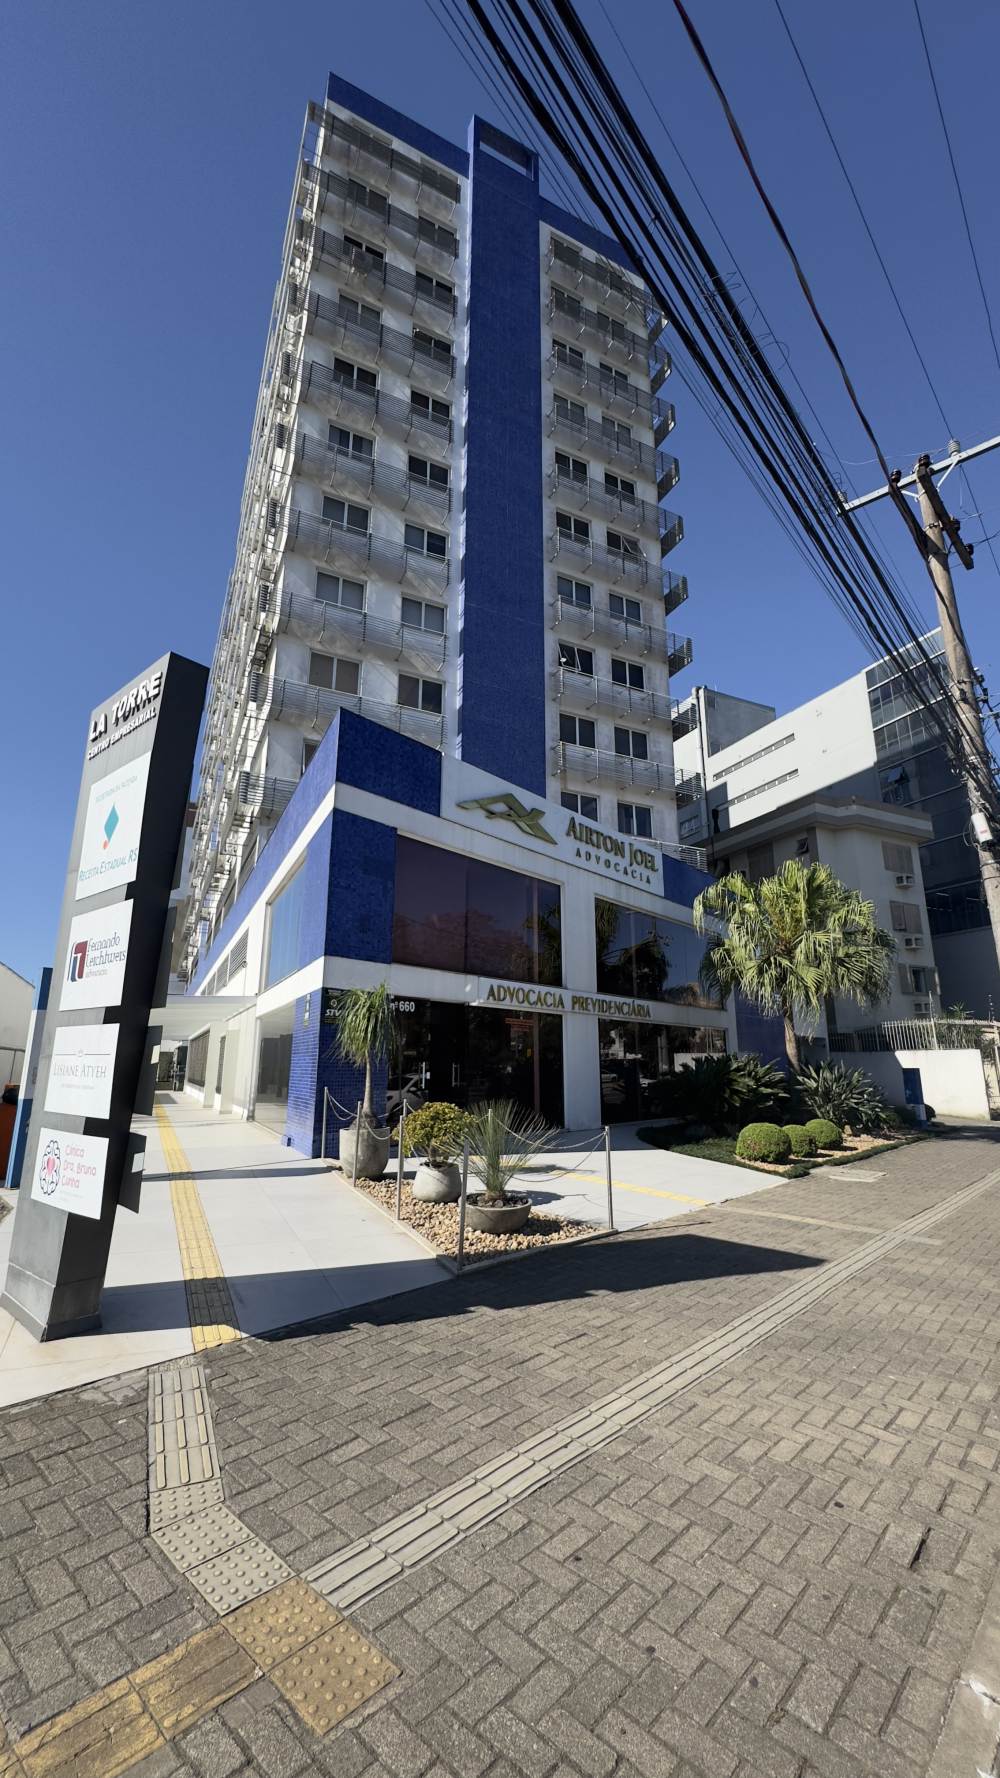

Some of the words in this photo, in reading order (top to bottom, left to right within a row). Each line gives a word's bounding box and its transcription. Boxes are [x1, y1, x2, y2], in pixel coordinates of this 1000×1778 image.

[89, 713, 107, 741] LA
[112, 671, 162, 726] TORRE
[88, 738, 110, 760] CENTRO
[111, 707, 156, 745] EMPRESARIAL
[100, 856, 126, 874] ESTADUAL
[128, 848, 138, 863] RS
[566, 816, 625, 859] AIRTON
[628, 842, 659, 872] JOEL
[575, 847, 651, 884] ADVOCACIA
[88, 932, 120, 952] Fernando
[325, 1008, 342, 1017] STV
[399, 1001, 415, 1012] 660
[486, 984, 565, 1009] ADVOCACIA
[571, 995, 651, 1018] PREVIDENCIÁRIA
